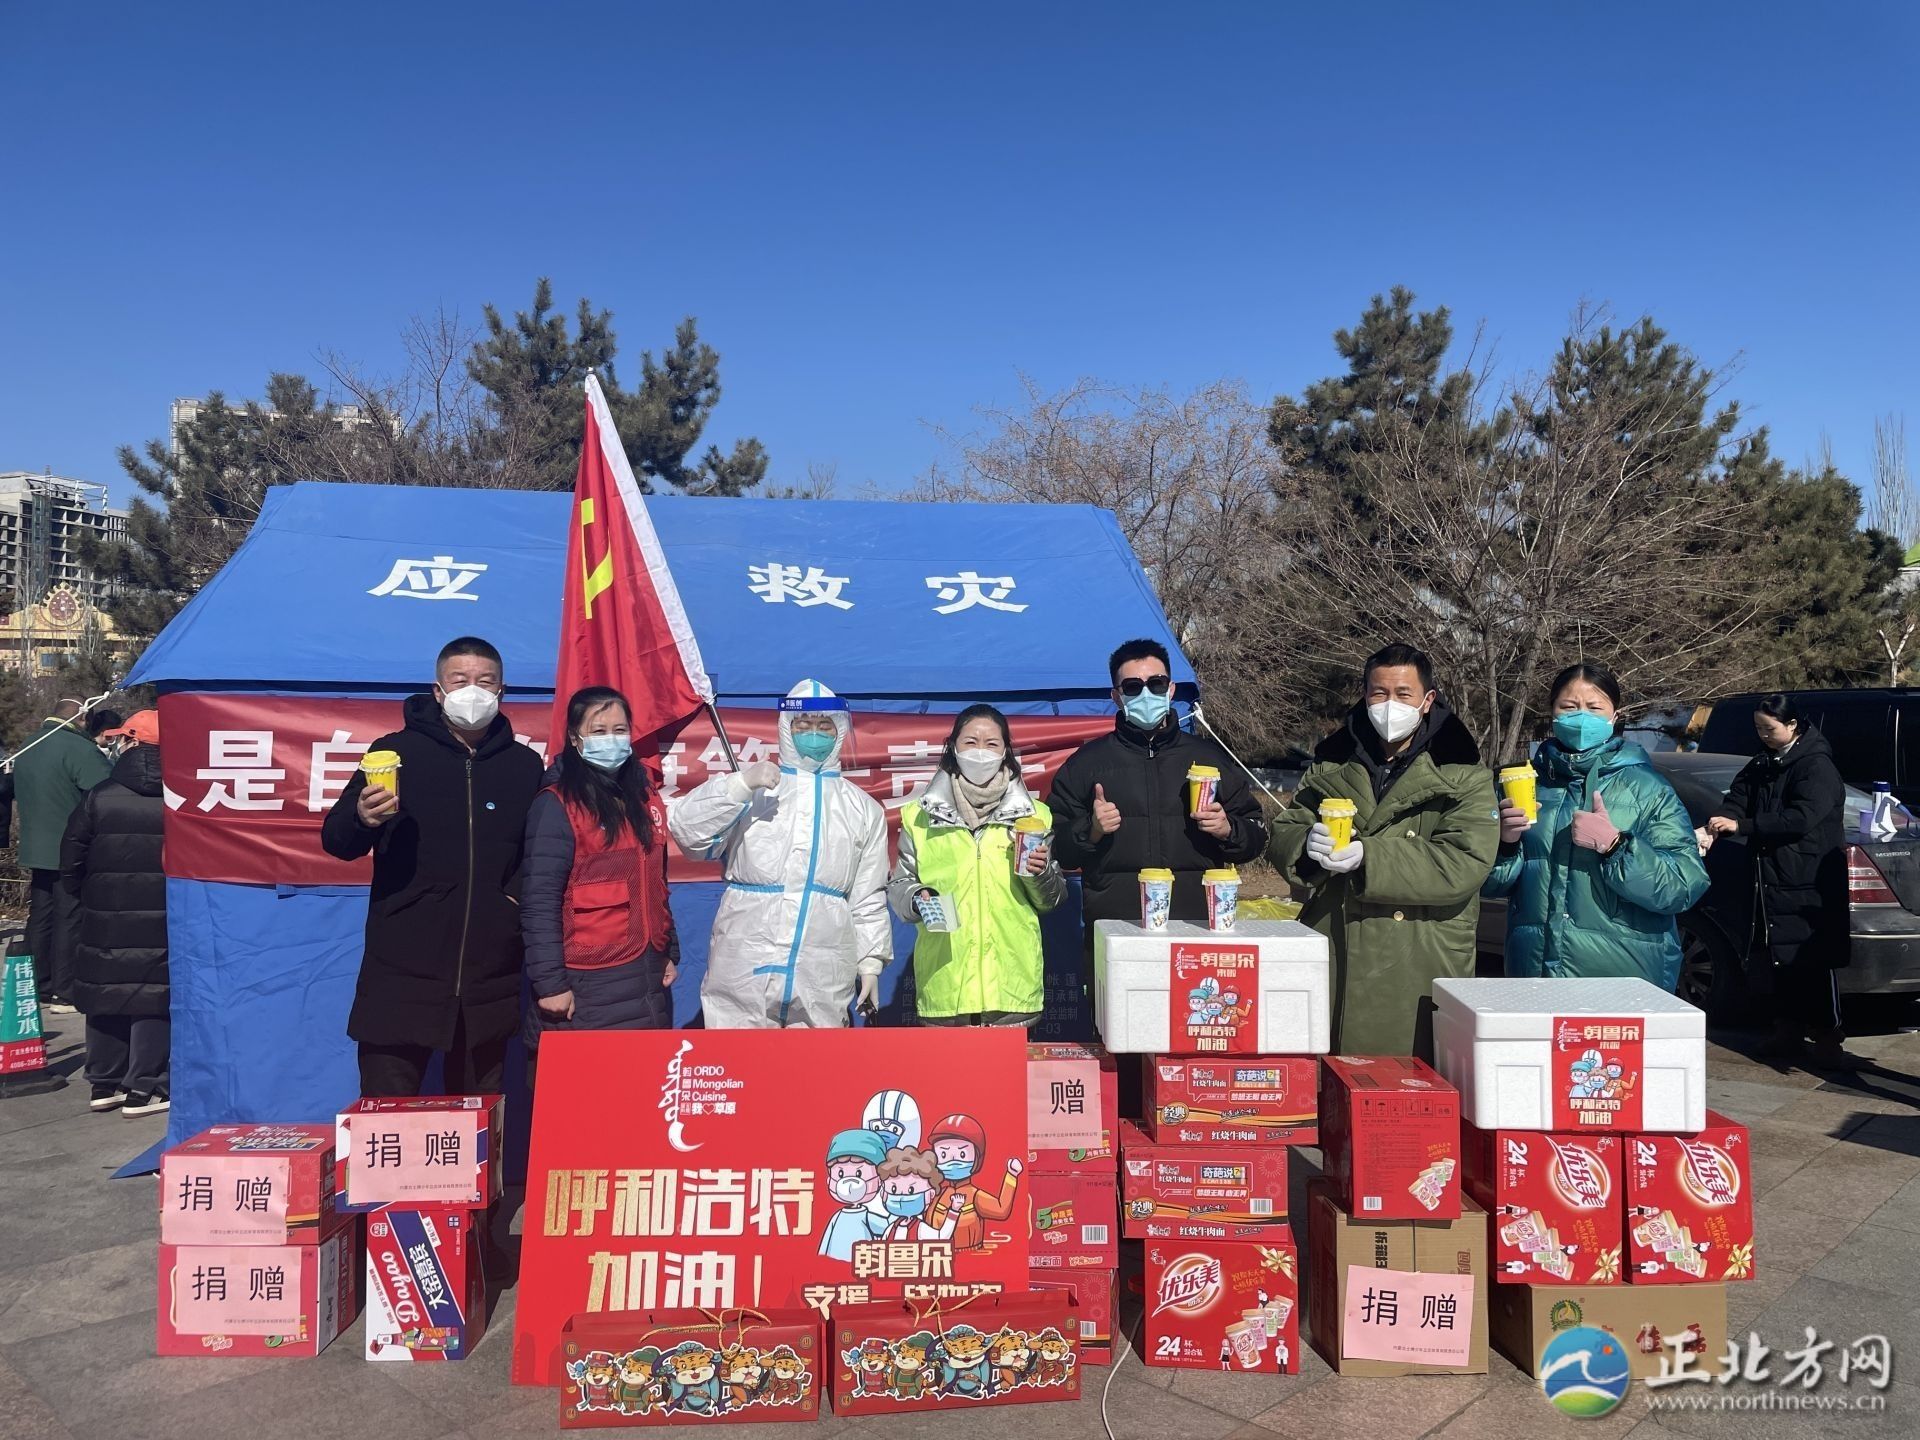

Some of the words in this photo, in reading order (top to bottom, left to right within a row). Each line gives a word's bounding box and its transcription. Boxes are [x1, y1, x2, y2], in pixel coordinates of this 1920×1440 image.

[693, 1065, 725, 1076] ORDO
[691, 1091, 727, 1102] Cuisine
[692, 1078, 744, 1091] Mongolian
[1050, 1078, 1085, 1115] 赠
[1163, 1105, 1185, 1118] 经典
[1211, 1130, 1257, 1141] 红烧牛肉面
[365, 1130, 461, 1169] 捐赠
[1508, 1138, 1528, 1166] 24
[1637, 1140, 1658, 1167] 24
[178, 1174, 272, 1213] 捐赠
[543, 1167, 815, 1237] 呼和浩特
[1131, 1200, 1154, 1213] 经典
[1179, 1226, 1226, 1237] 红烧牛肉面
[191, 1264, 284, 1301] 捐赠
[381, 1251, 421, 1324] Dayao
[1157, 1259, 1221, 1306] 优乐美
[1361, 1286, 1457, 1330] 捐赠
[1155, 1335, 1181, 1356] 24
